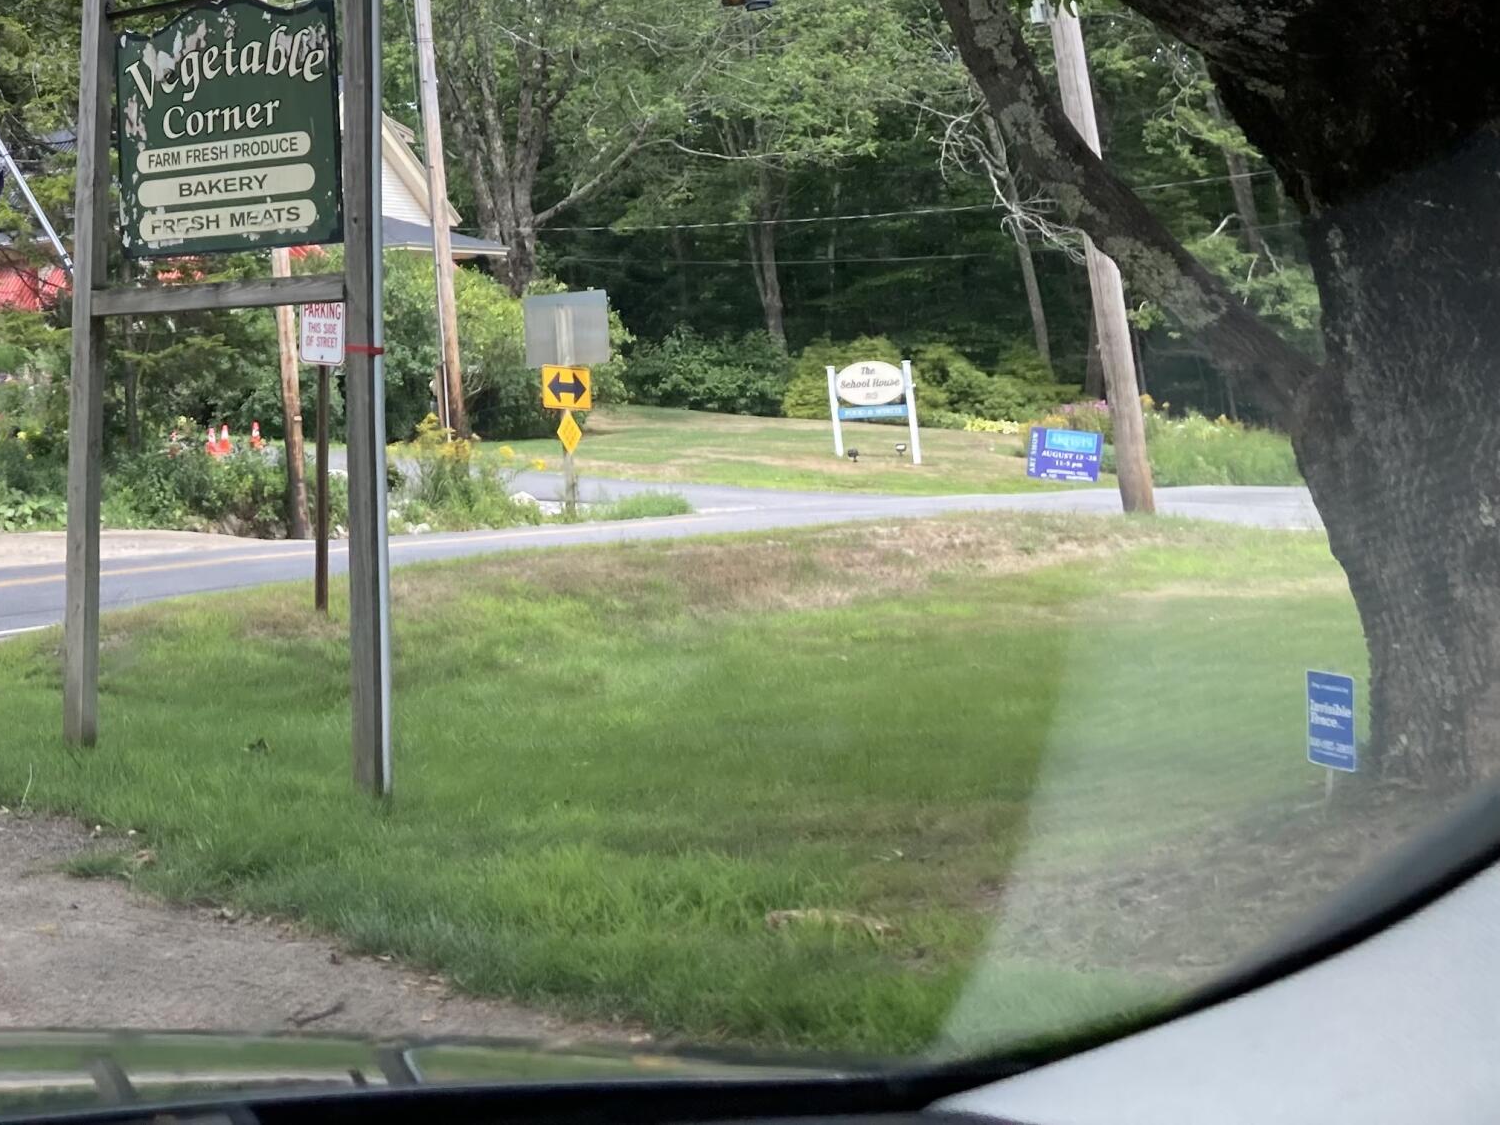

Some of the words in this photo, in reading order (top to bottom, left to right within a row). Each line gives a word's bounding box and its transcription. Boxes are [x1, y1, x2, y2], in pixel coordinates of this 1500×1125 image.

[125, 25, 325, 109] Vegetable
[162, 99, 280, 139] Corner
[147, 153, 181, 169] FARM
[185, 147, 228, 165] FRESH
[233, 136, 299, 157] PRODUCE
[178, 173, 268, 198] BAKERY
[150, 214, 220, 235] FRESH
[229, 206, 301, 228] MEATS
[304, 303, 341, 320] PARKING
[309, 322, 321, 333] THIS
[324, 324, 337, 334] SIDE
[307, 335, 314, 346] OF
[317, 337, 338, 348] STREET
[861, 366, 875, 375] The
[840, 378, 870, 389] School
[872, 377, 901, 388] House
[1042, 450, 1074, 460] AUGUST
[1071, 461, 1083, 469] pm
[1309, 698, 1352, 719] Invisible
[1310, 711, 1337, 728] Fence
